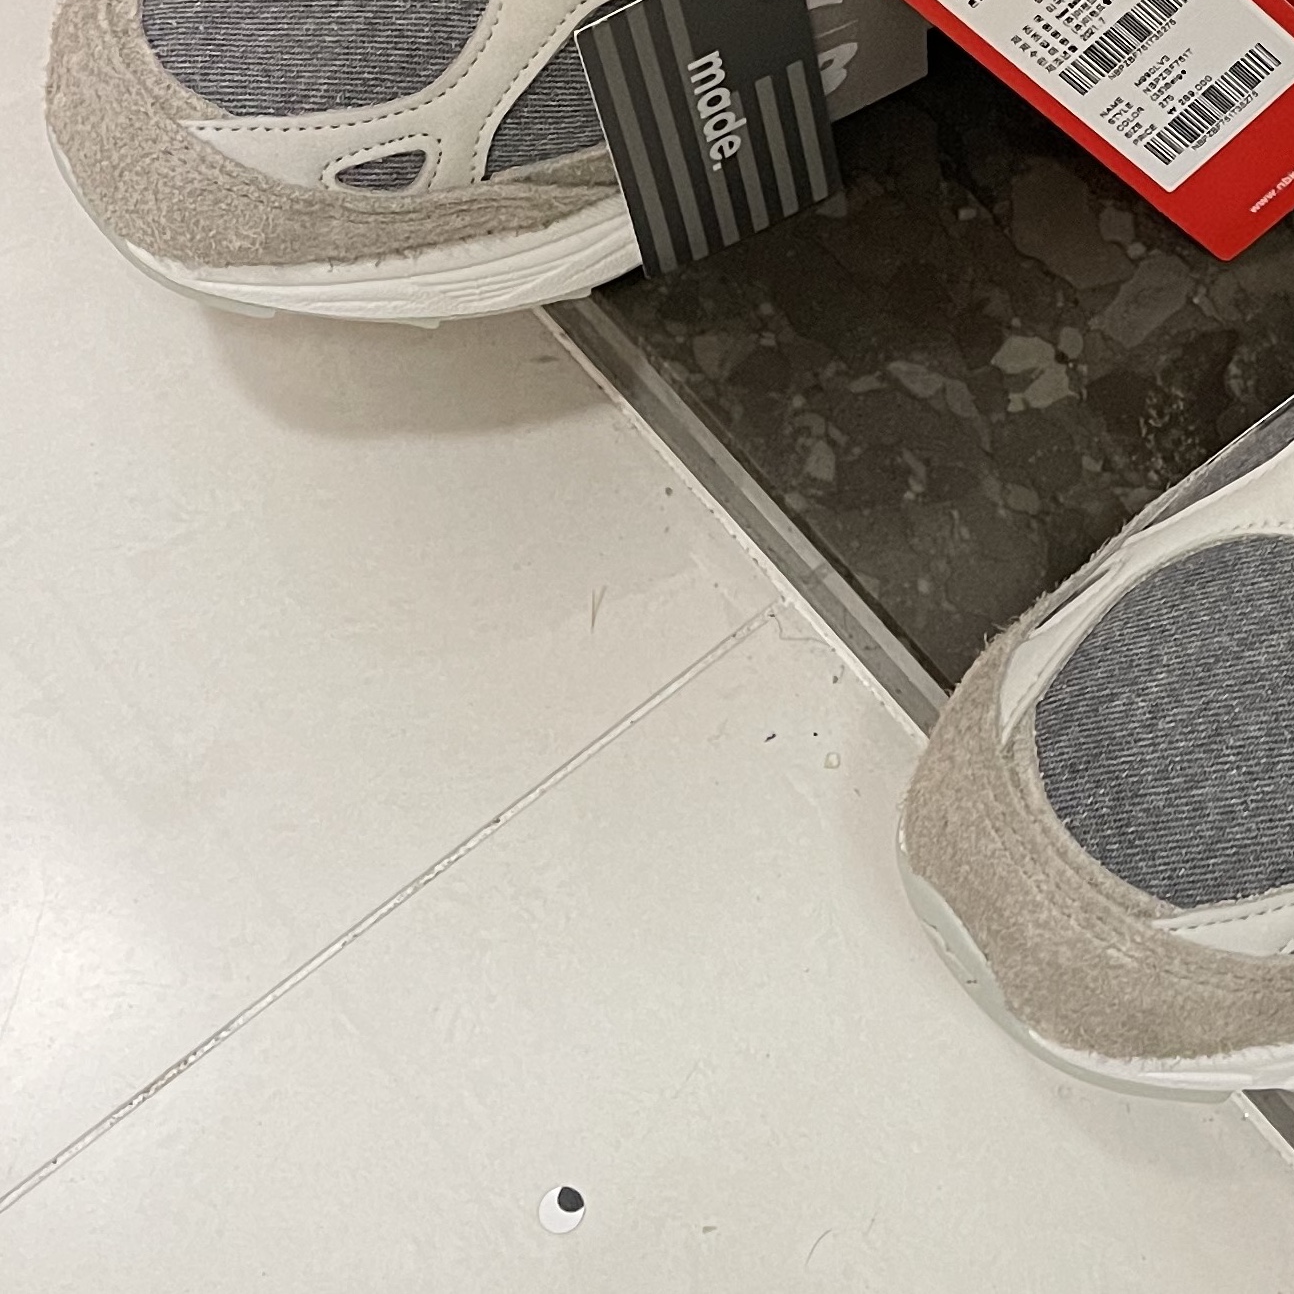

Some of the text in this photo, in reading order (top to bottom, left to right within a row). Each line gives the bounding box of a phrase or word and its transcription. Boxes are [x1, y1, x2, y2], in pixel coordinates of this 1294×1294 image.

[687, 50, 747, 171] made.
[1098, 96, 1124, 118] NAME
[1107, 101, 1134, 125] STYLE
[1115, 105, 1145, 132] COLOR
[1123, 121, 1143, 139] SIZE
[1131, 123, 1157, 146] PRICE
